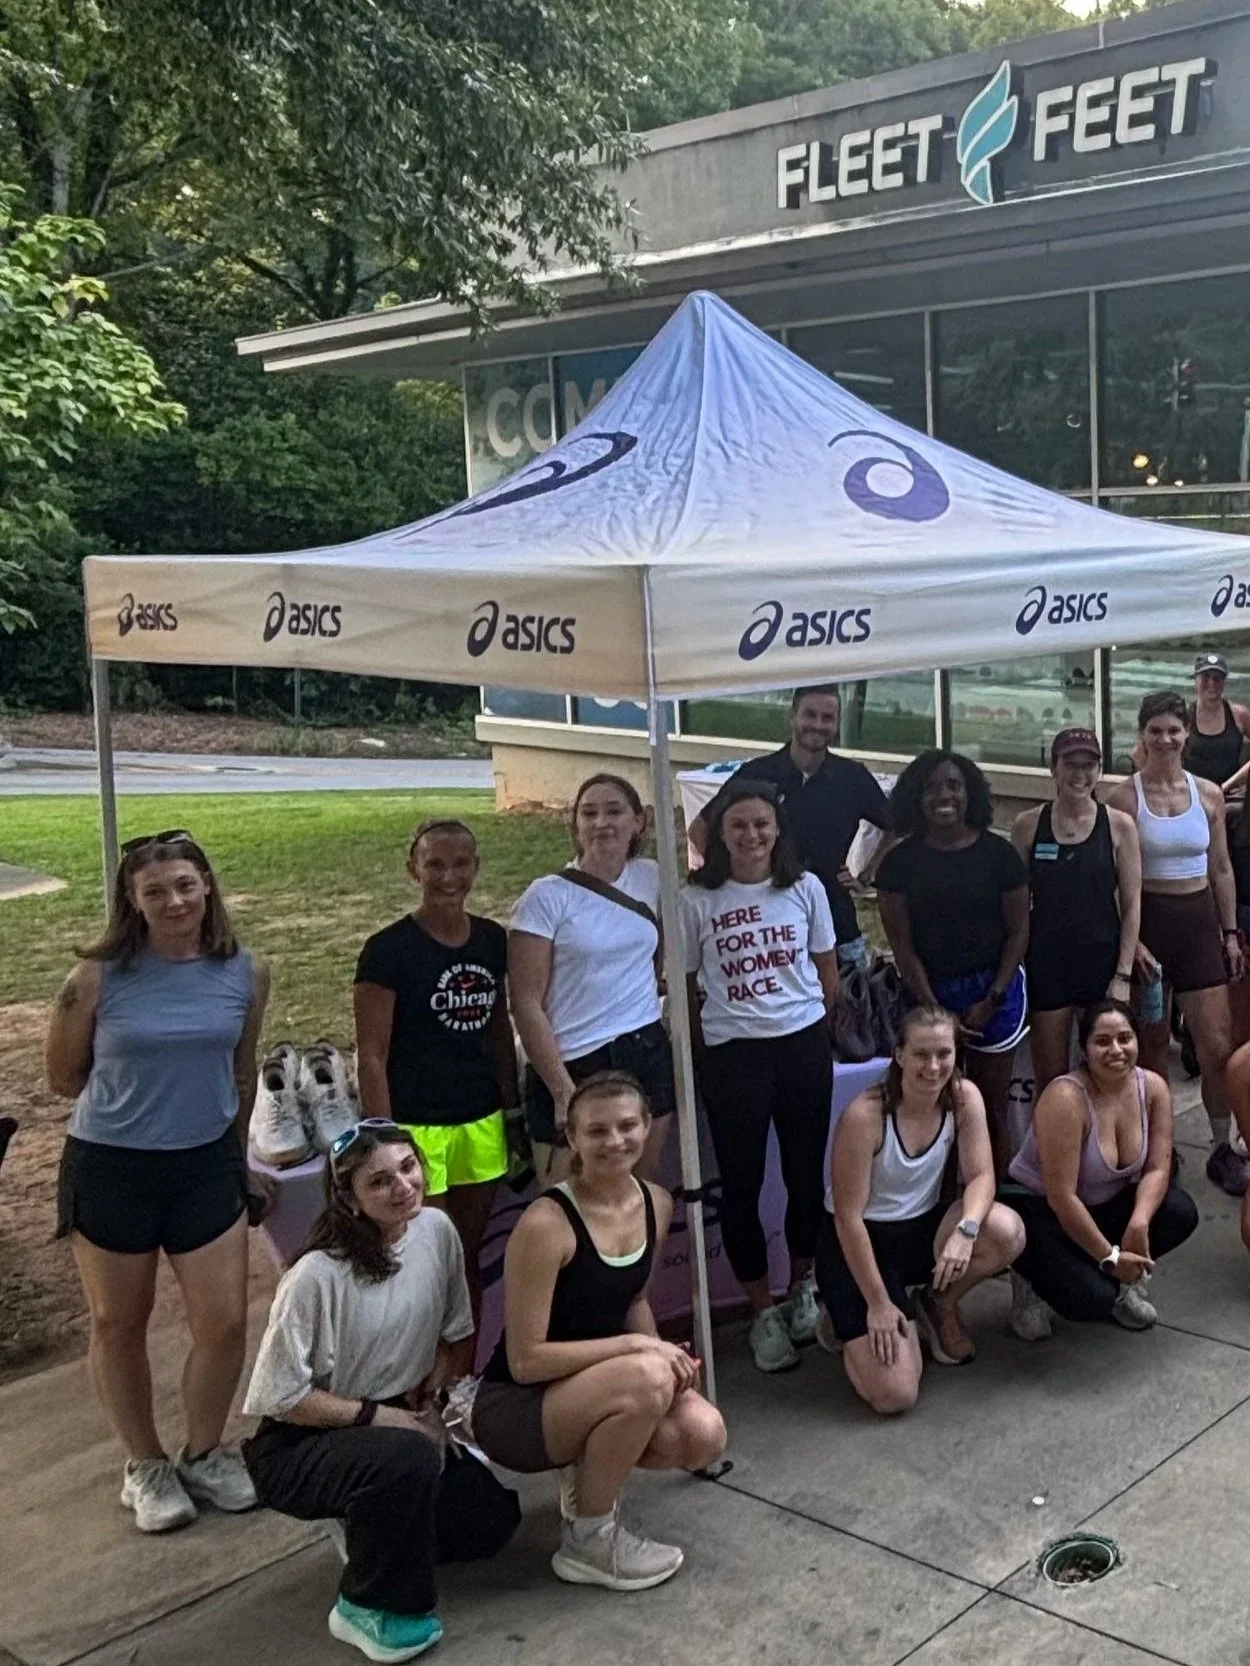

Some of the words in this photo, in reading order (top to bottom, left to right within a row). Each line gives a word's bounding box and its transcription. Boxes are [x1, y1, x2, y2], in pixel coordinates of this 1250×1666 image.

[777, 113, 943, 209] FLEET
[1033, 56, 1206, 162] FEET
[711, 905, 763, 933] HERE
[715, 931, 758, 956] FOR
[758, 924, 797, 945] THE
[727, 976, 783, 1002] RACE.
